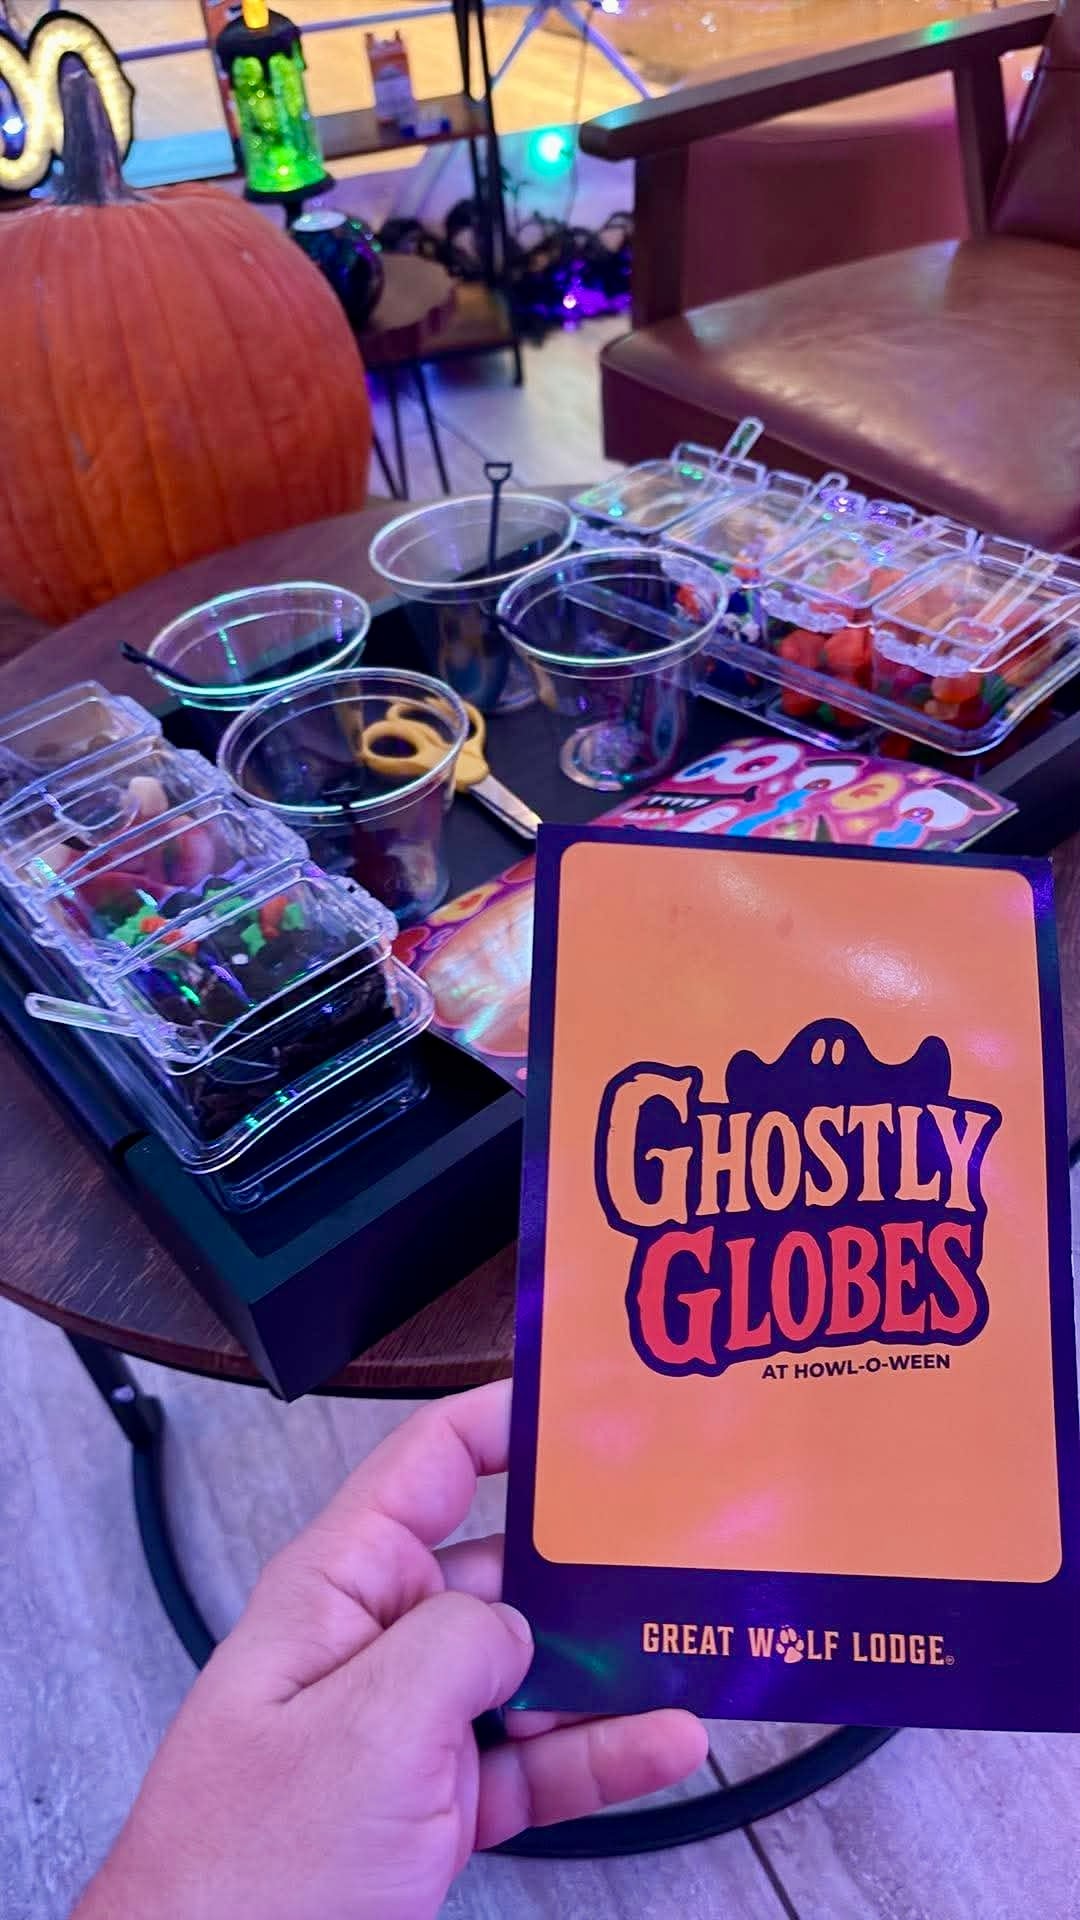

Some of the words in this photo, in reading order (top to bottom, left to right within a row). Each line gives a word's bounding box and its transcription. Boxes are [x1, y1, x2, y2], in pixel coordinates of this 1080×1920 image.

[606, 1073, 991, 1226] GHOSTLY
[637, 1222, 978, 1364] GLOBES
[761, 1364, 788, 1379] AT
[794, 1354, 950, 1379] HOWL-O-WEEN
[643, 1623, 734, 1656] GREAT
